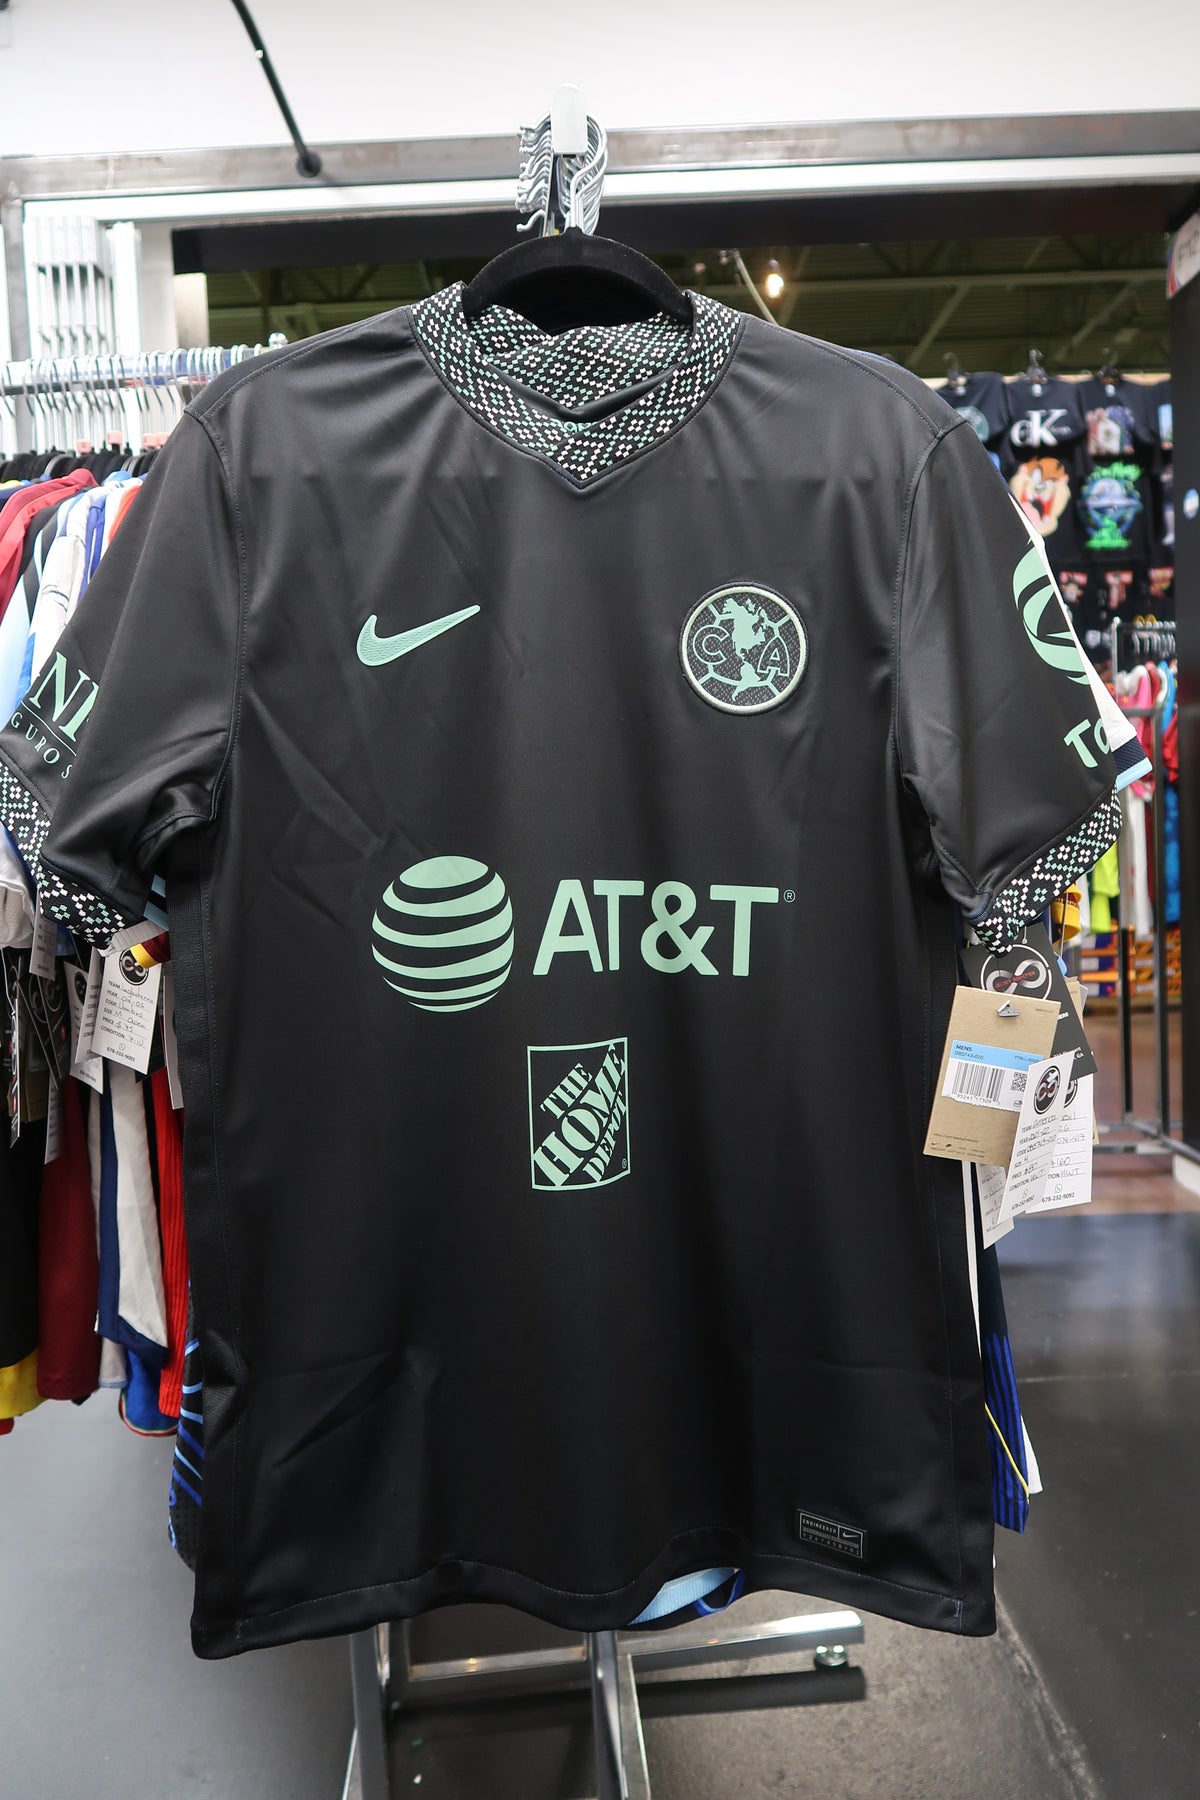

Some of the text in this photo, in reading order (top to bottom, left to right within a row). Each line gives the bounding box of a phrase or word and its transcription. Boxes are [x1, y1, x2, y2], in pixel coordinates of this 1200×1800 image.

[532, 879, 779, 977] AT&T
[539, 1062, 593, 1119] THE
[955, 1044, 973, 1052] MENS
[532, 1042, 626, 1188] HOME
[582, 1089, 627, 1183] DEPOT
